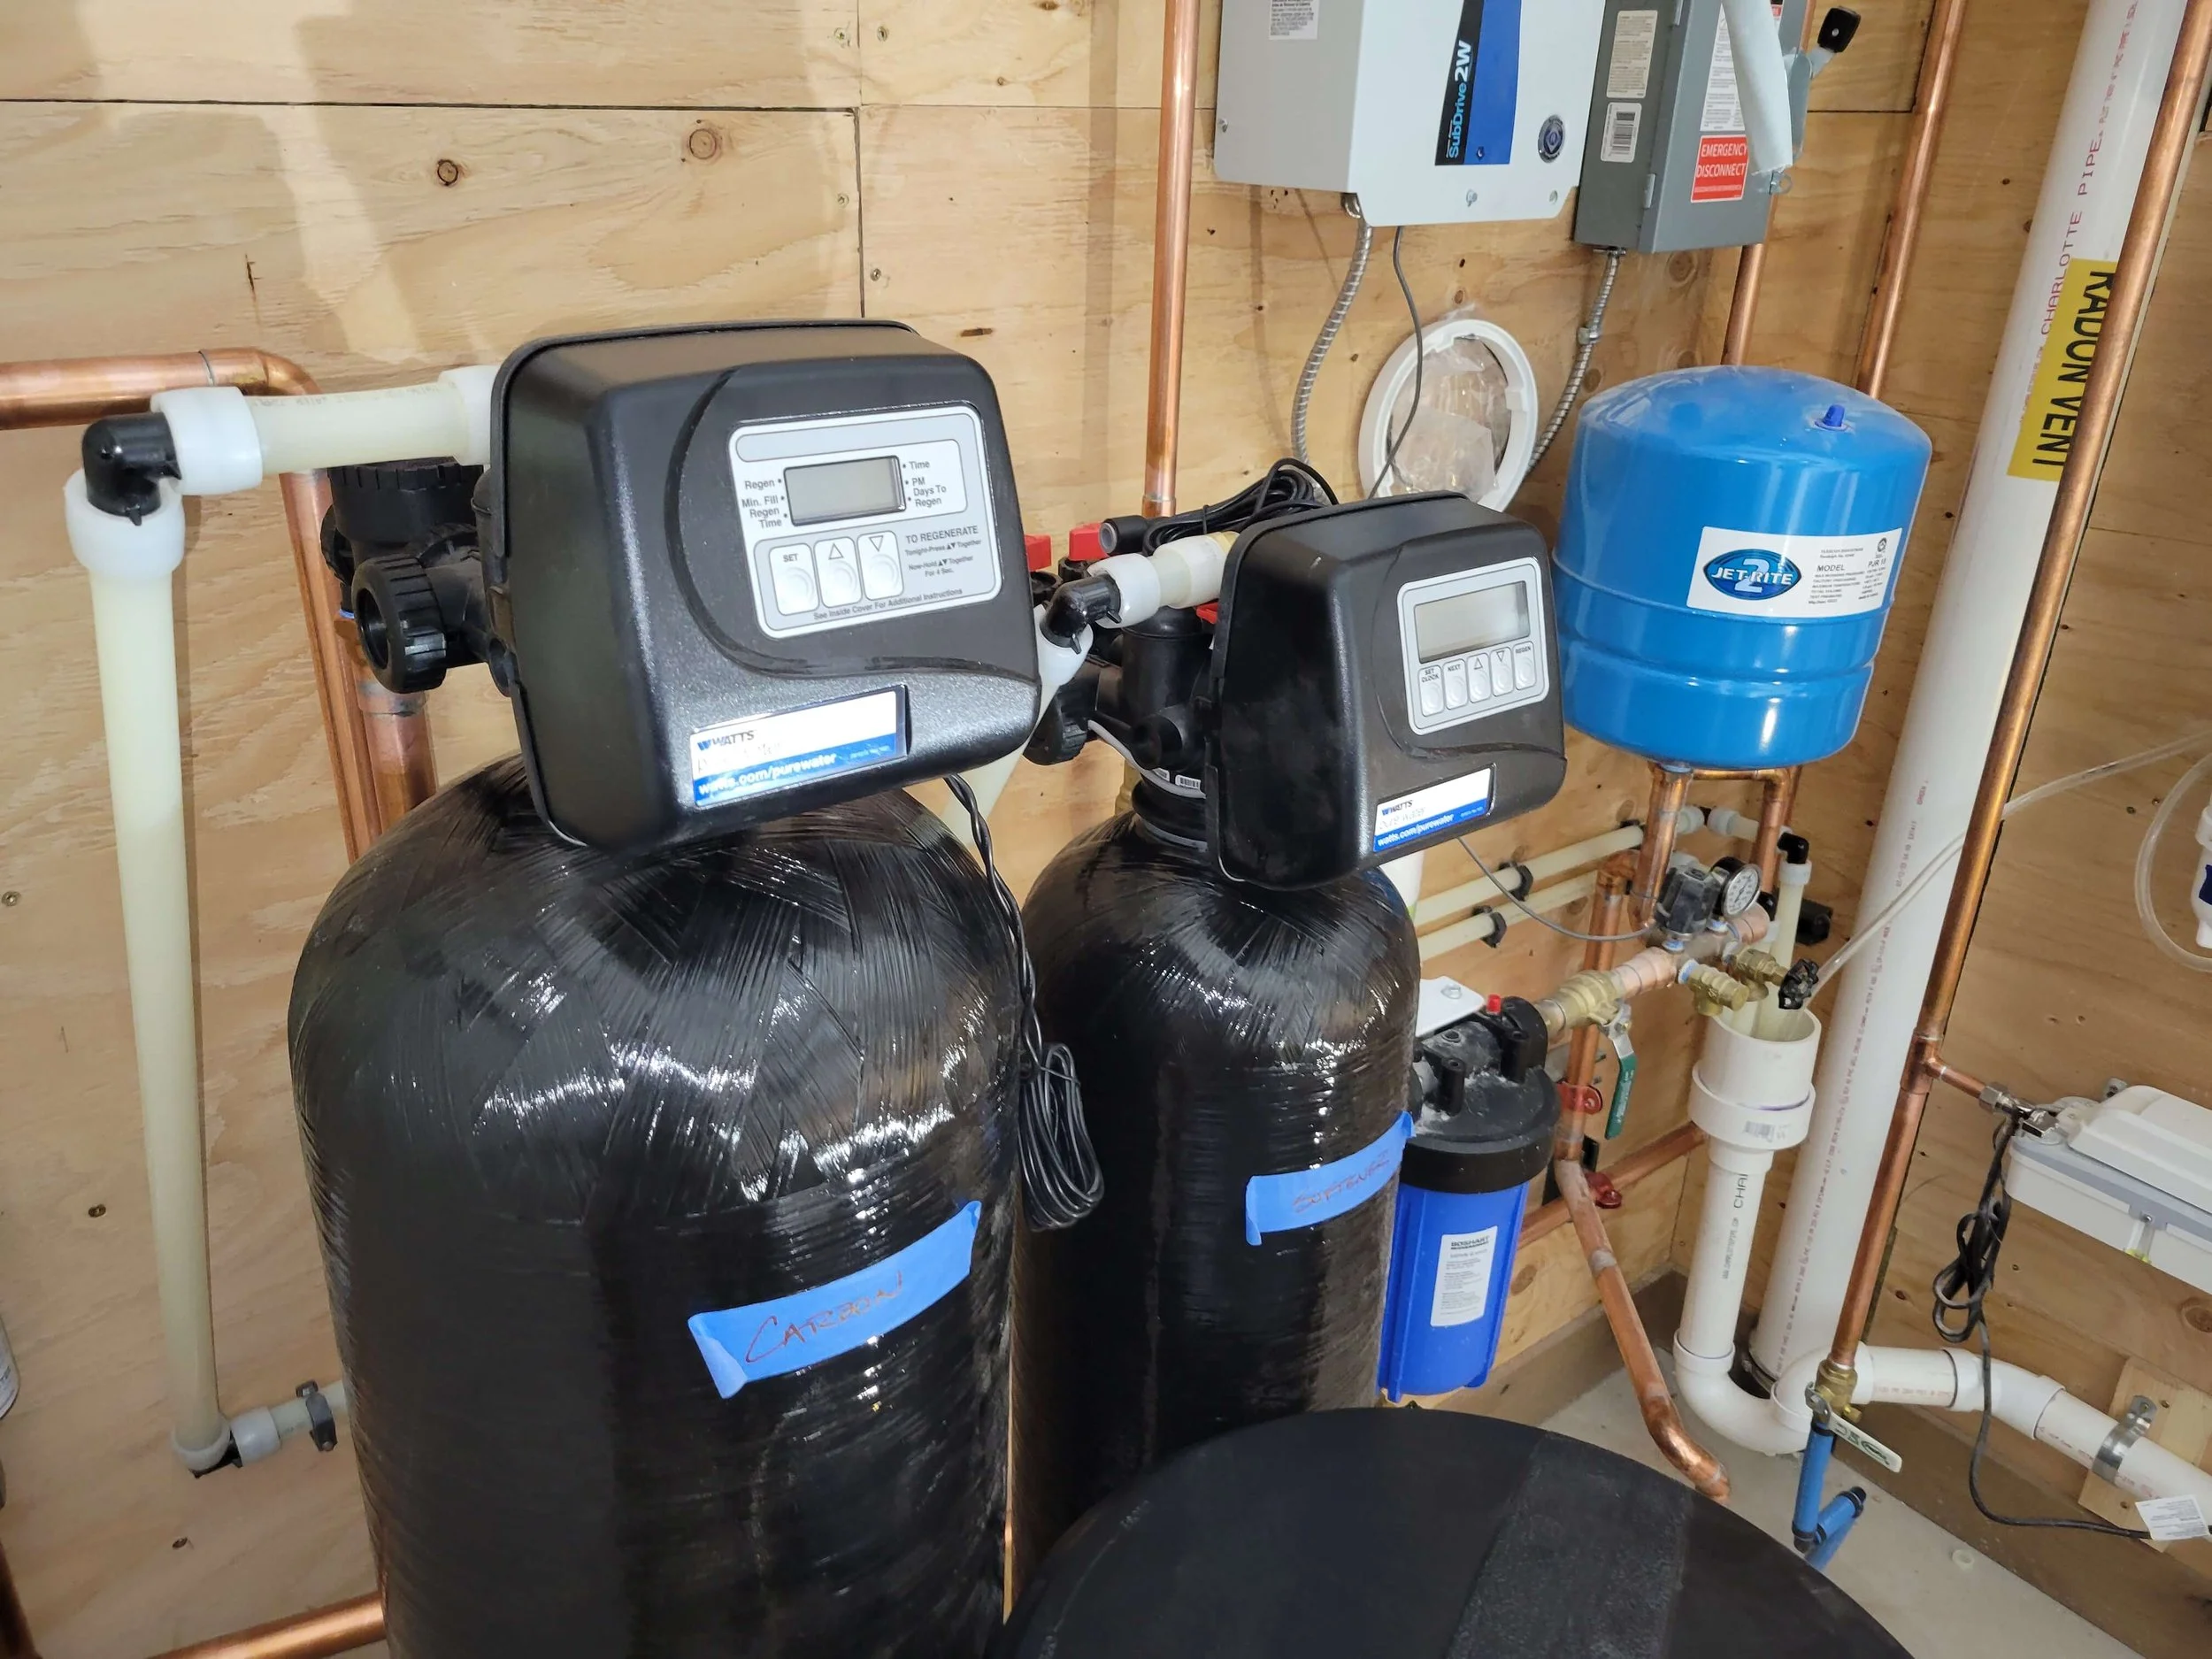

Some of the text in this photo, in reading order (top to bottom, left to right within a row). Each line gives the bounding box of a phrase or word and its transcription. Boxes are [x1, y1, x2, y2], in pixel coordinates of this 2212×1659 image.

[1696, 163, 1747, 177] DISCONNECT
[2040, 138, 2102, 335] CHARLOTTE PIPE
[910, 460, 930, 470] Time
[744, 478, 774, 490] Regen
[912, 477, 926, 486] PM
[913, 485, 947, 496] Days To
[741, 495, 779, 508] Min. Fill
[915, 496, 942, 508] Regen
[749, 506, 780, 518] Regen
[760, 518, 782, 529] Time
[906, 526, 979, 544] TO REGENERATE
[783, 553, 798, 562] SET
[1734, 558, 1770, 593] 2
[814, 611, 827, 620] See
[829, 608, 851, 618] Inside
[852, 603, 873, 612] Cover
[887, 595, 922, 607] Additional
[711, 730, 755, 746] WATTS
[1388, 800, 1413, 813] WATTS
[1378, 813, 1455, 847] watts.com/purewater
